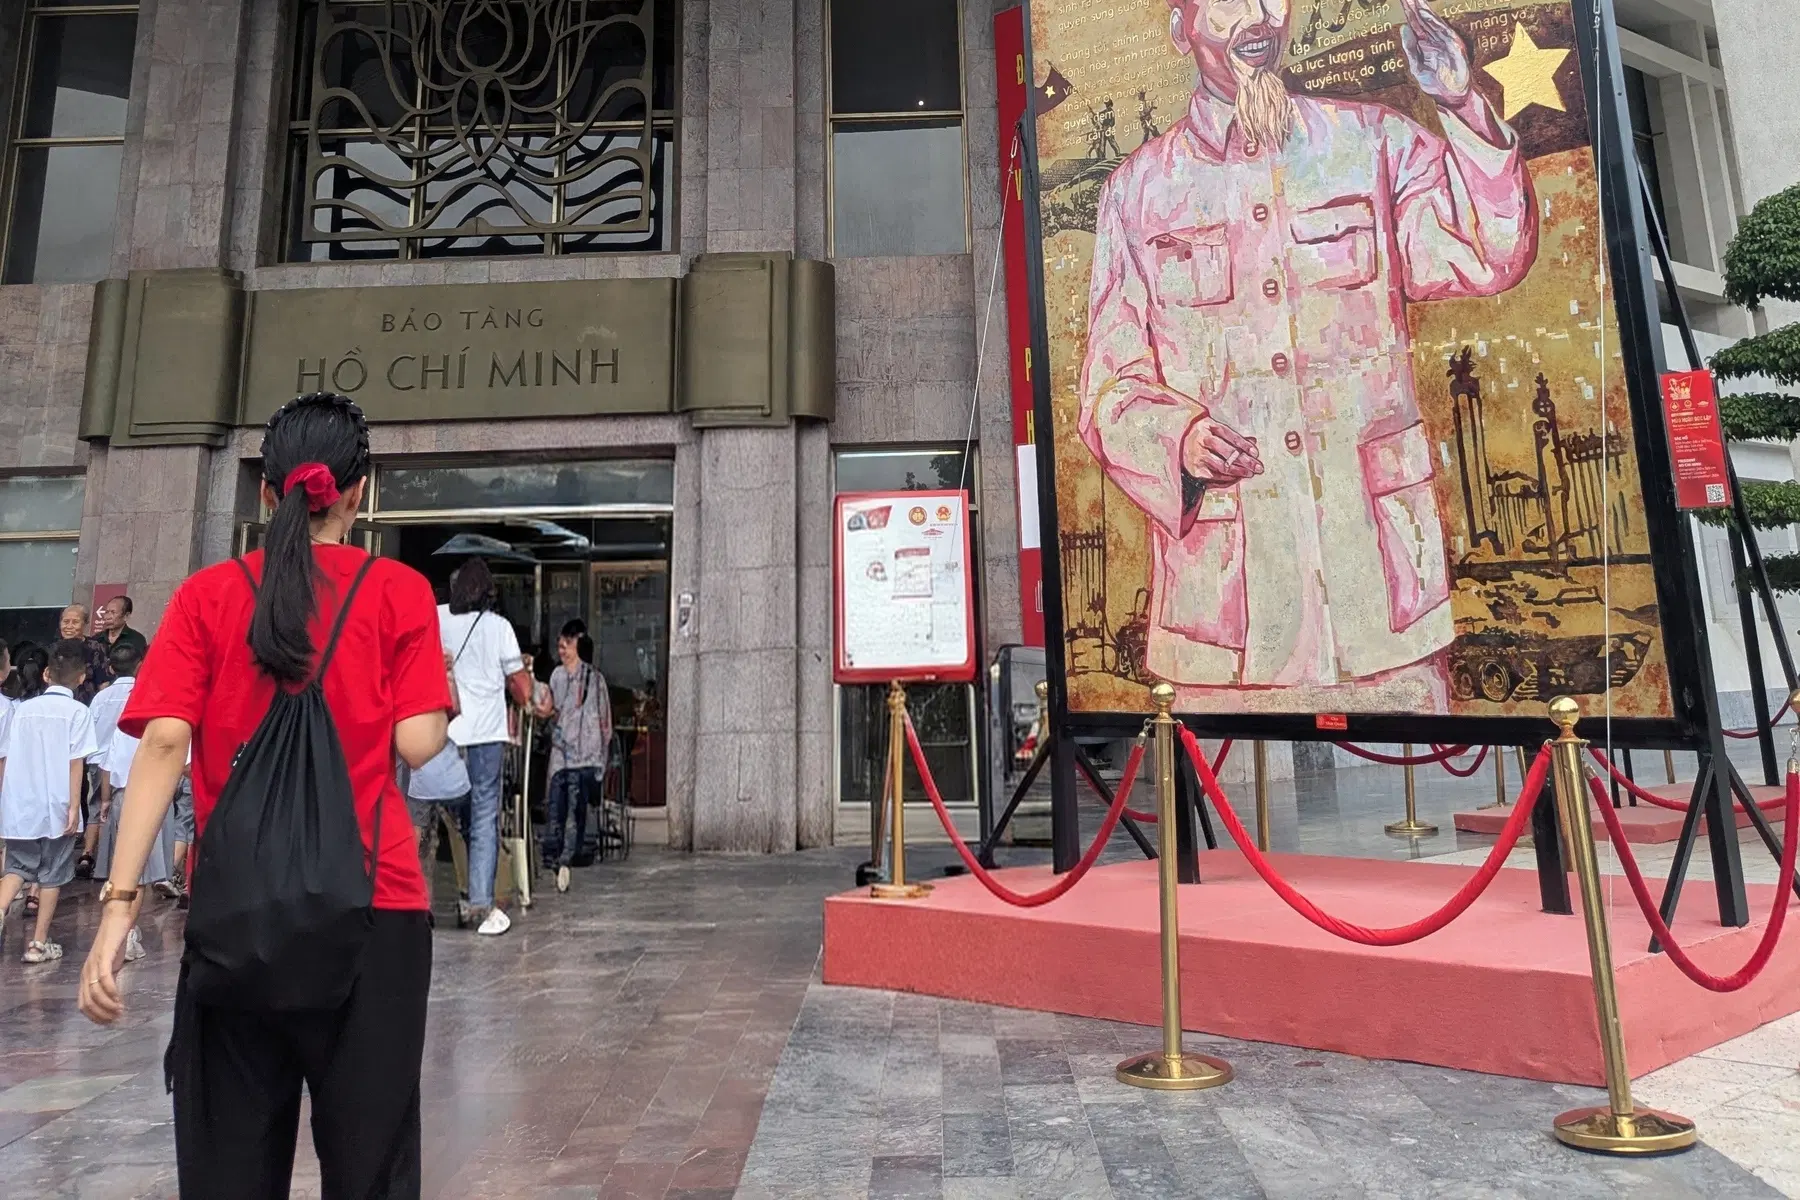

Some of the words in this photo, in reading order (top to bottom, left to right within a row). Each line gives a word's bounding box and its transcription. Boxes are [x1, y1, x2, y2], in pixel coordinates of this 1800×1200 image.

[1470, 13, 1507, 31] mạng
[1305, 70, 1340, 90] quyền
[1359, 65, 1375, 77] do
[381, 308, 443, 332] BẢO
[460, 305, 544, 331] TÀNG
[296, 345, 369, 394] HỒ
[387, 346, 470, 391] CHÍ
[488, 348, 619, 388] MINH
